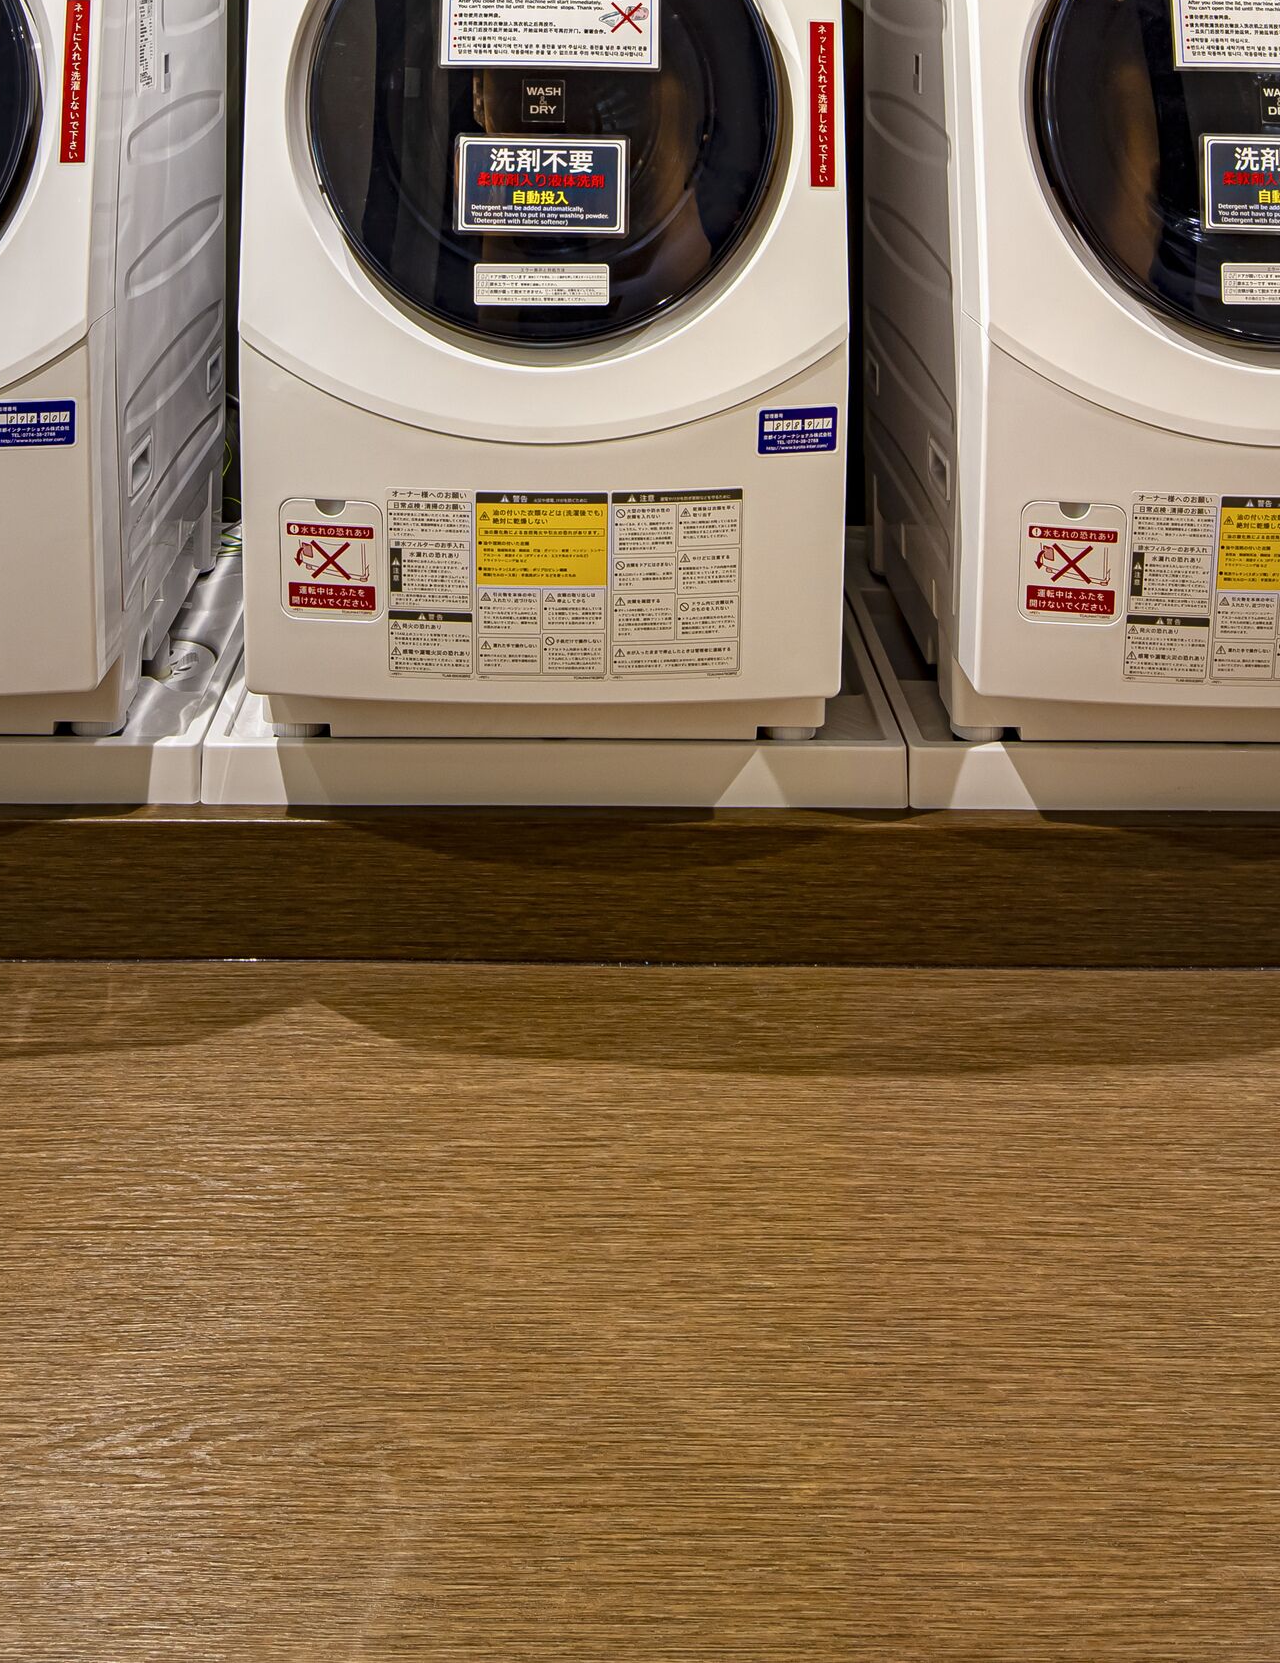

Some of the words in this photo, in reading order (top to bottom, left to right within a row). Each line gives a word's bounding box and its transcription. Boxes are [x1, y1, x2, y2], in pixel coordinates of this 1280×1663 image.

[68, 2, 84, 161] ネットに入れて洗濯しないで下さい
[527, 87, 561, 96] WASH
[539, 96, 547, 105] &
[817, 24, 828, 184] ネットに入れて洗濯しないで下さい
[530, 106, 557, 114] DRY
[490, 147, 594, 173] 洗剤不要
[477, 172, 605, 188] 柔軟剤入り液体洗剤
[512, 190, 569, 205] 自動投入
[541, 218, 568, 226] softener)
[302, 524, 372, 538] 水もれの恐れあり
[1042, 528, 1116, 542] 水もれの恐れあり
[299, 586, 360, 598] 運転中は、ふたを
[1037, 589, 1104, 602] 運転中は、ふたを
[292, 595, 368, 608] 開けないでください。
[1028, 598, 1112, 612] 開けないでください。
